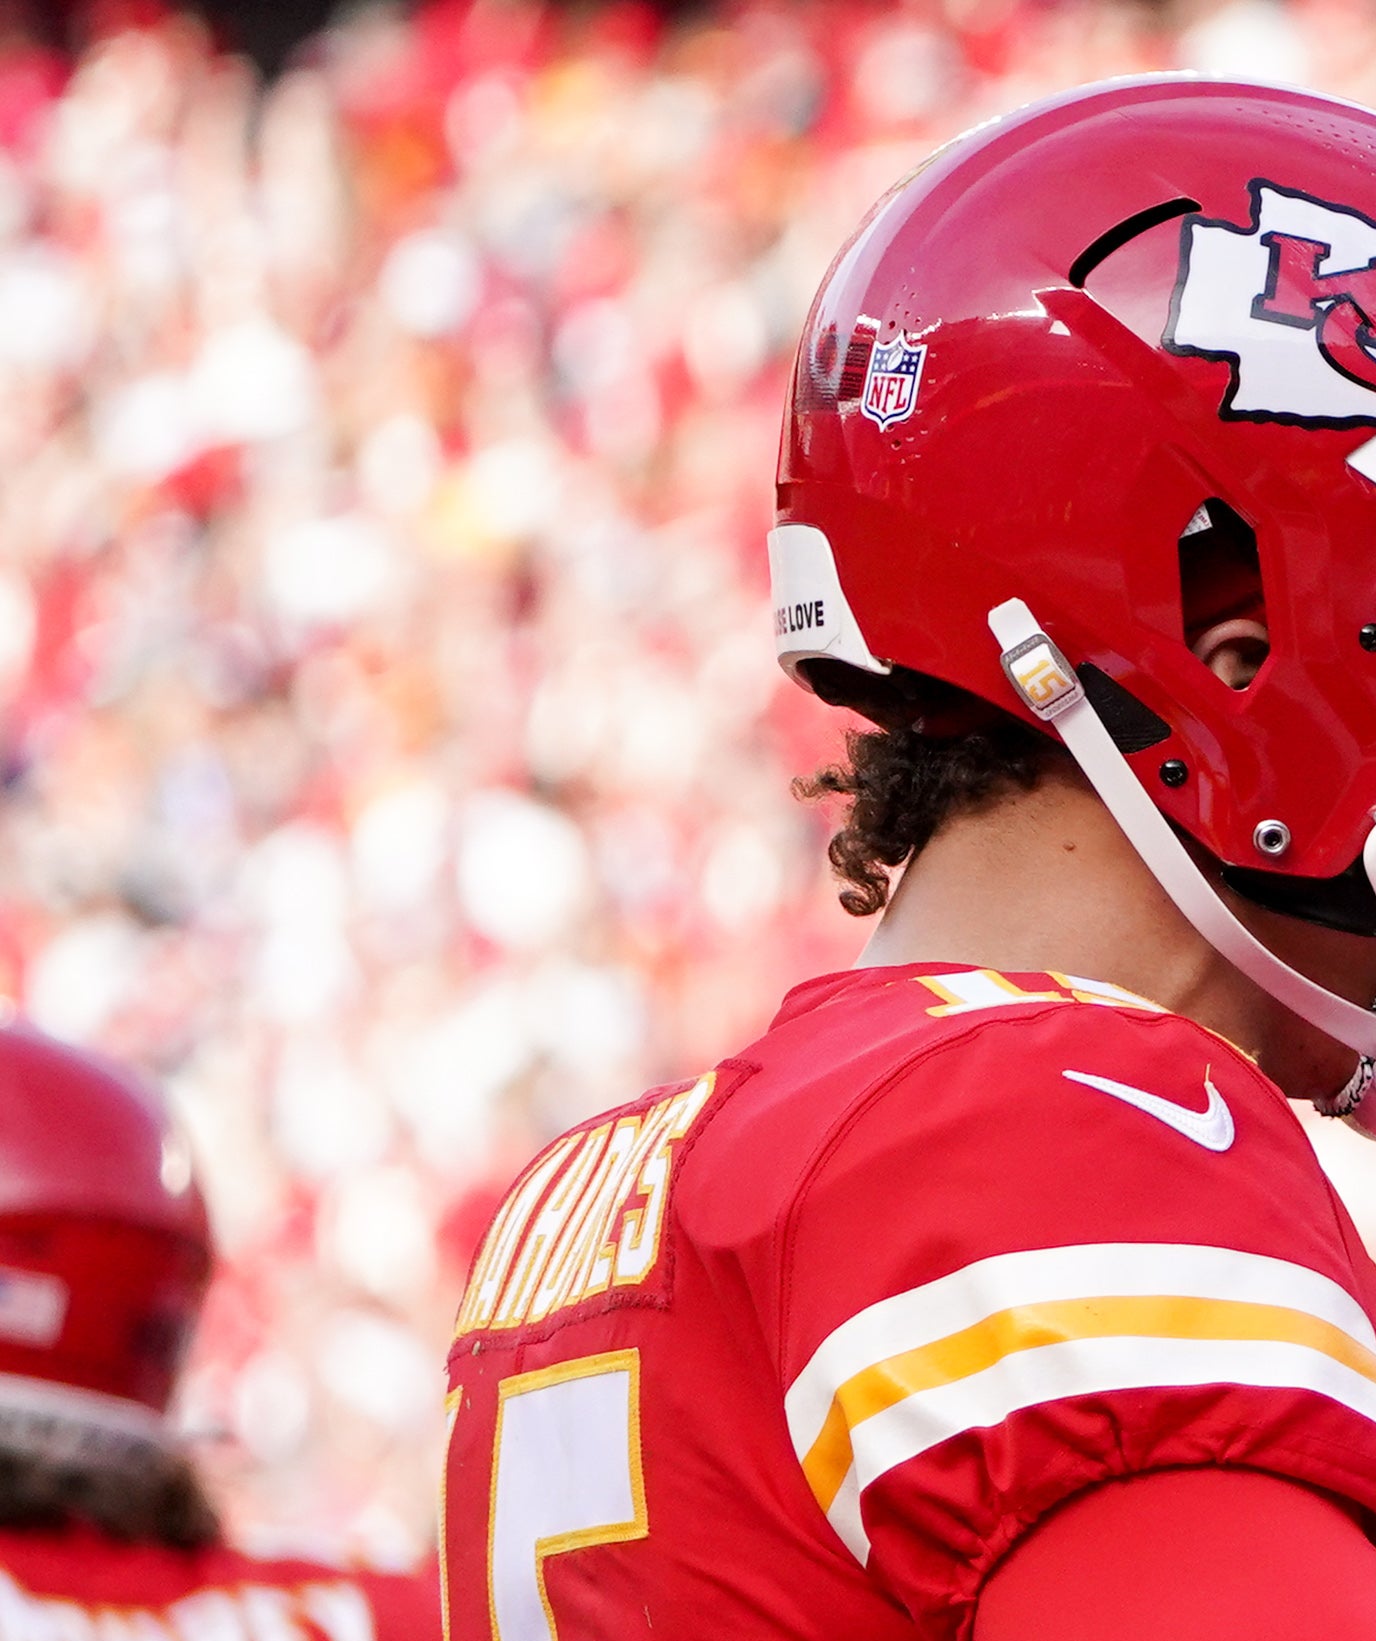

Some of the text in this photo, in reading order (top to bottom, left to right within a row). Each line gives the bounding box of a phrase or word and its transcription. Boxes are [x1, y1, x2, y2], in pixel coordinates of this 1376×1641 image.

[869, 376, 907, 413] NFL
[788, 600, 825, 633] LOVE
[1018, 660, 1068, 702] 15
[454, 1071, 717, 1338] AHOMES
